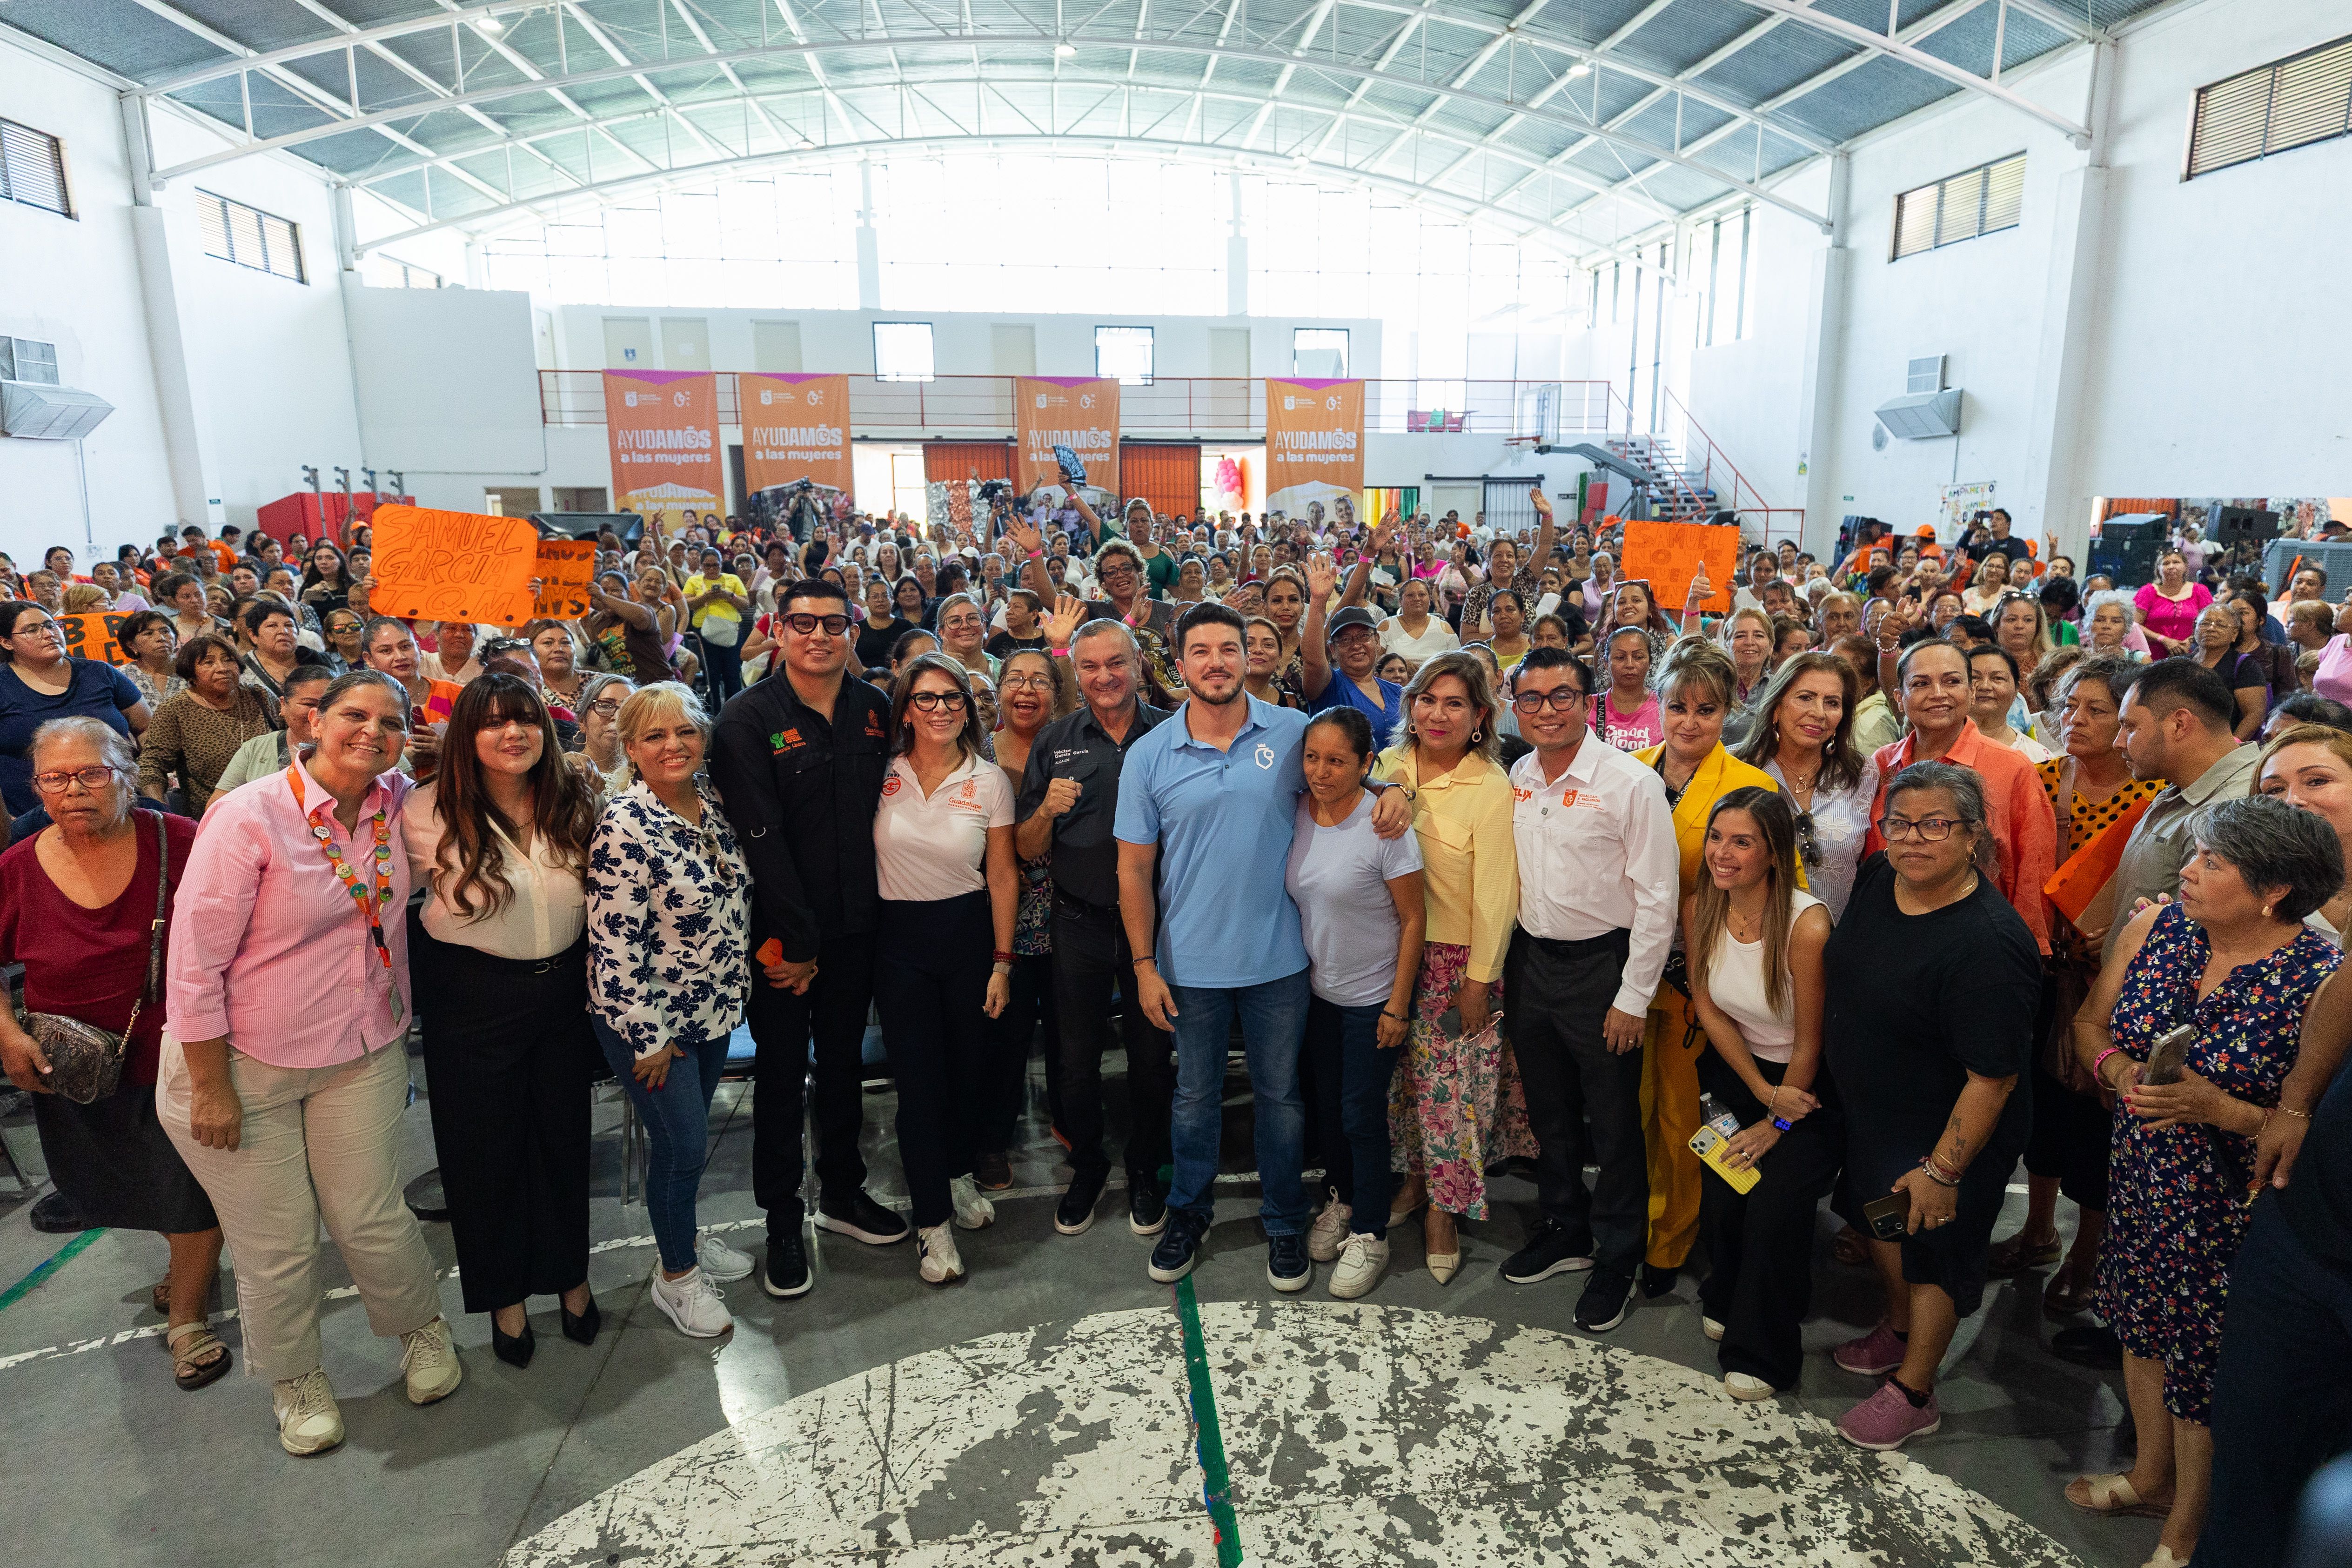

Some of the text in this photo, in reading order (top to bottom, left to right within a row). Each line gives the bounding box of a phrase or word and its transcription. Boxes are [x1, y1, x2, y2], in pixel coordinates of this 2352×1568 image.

[621, 451, 711, 465] a las mujeres
[755, 449, 842, 462] a las mujeres
[1030, 453, 1037, 462] a
[1277, 451, 1354, 464] a las mujeres
[378, 510, 523, 555] SAMUEL
[1629, 524, 1724, 549] SAMUEL
[1631, 549, 1722, 566] NO TE
[377, 548, 505, 587] GARCIA
[1169, 665, 1182, 684] KORS
[949, 797, 982, 810] Guadalupe
